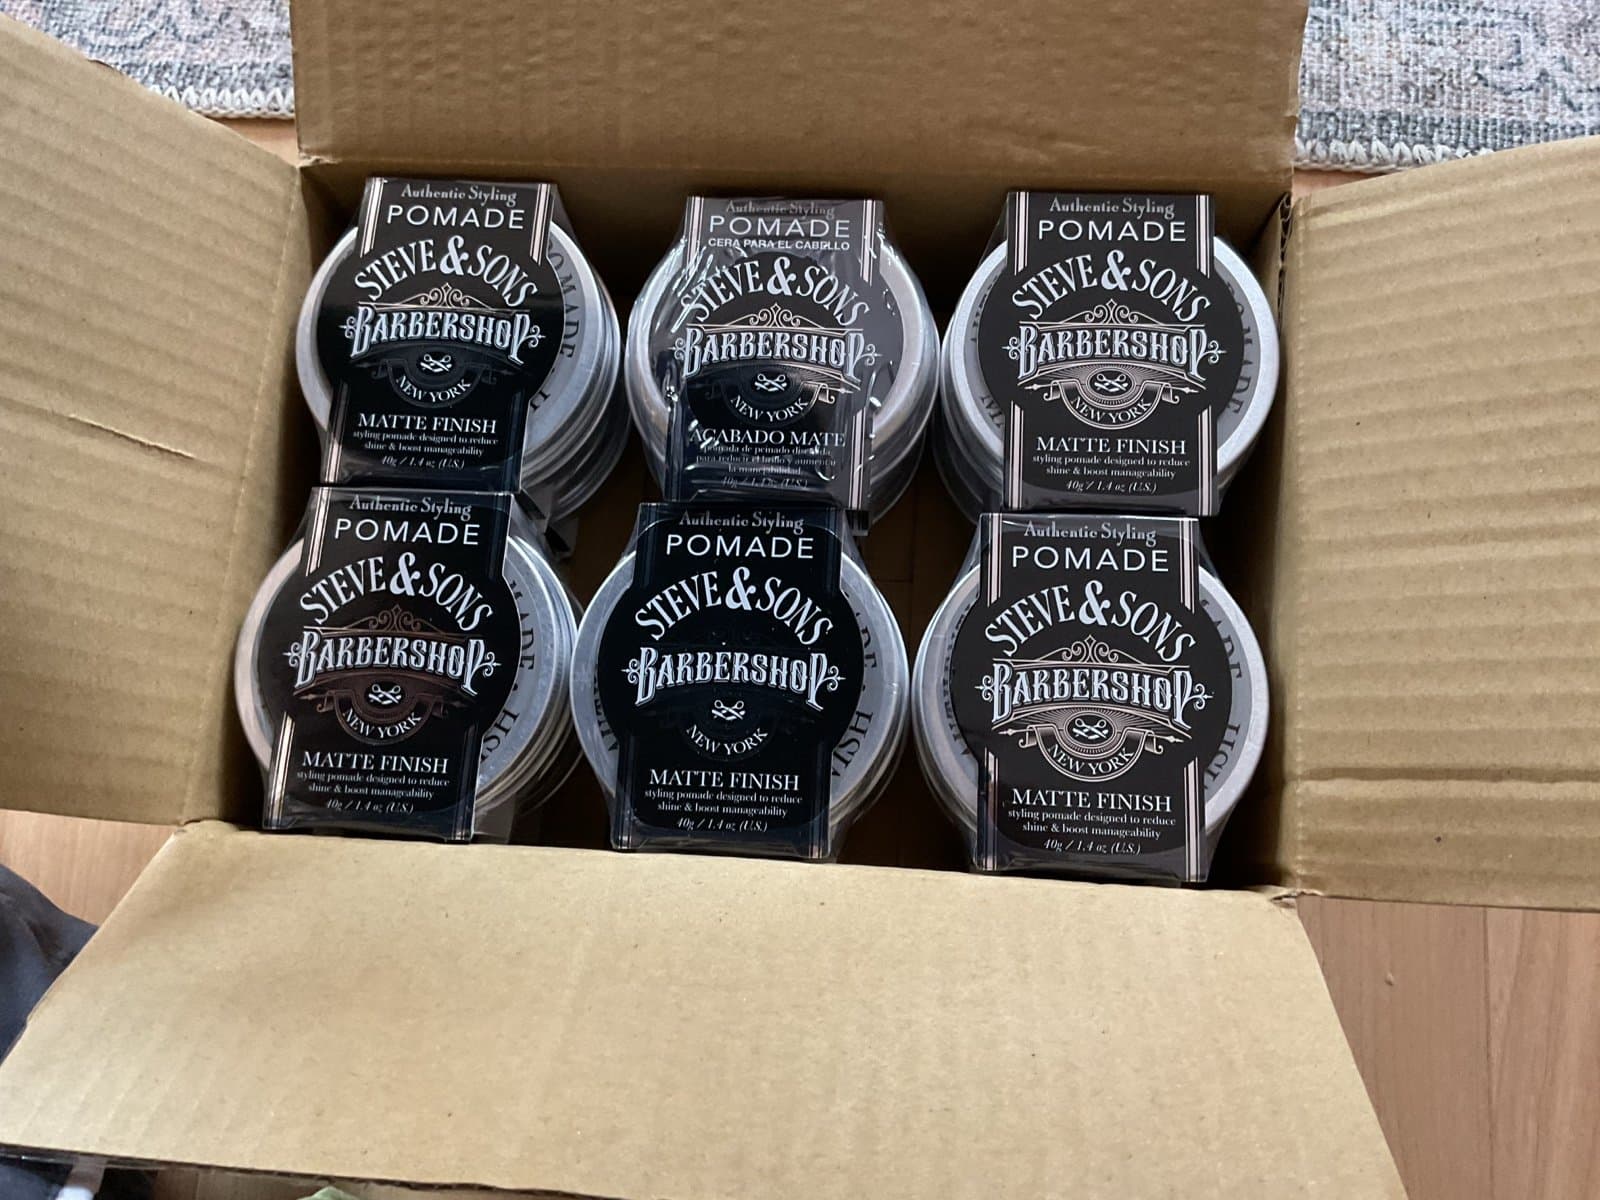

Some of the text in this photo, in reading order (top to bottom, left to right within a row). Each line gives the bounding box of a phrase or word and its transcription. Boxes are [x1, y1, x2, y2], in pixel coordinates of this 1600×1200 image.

[401, 187, 517, 207] Authentic Styling
[387, 205, 525, 229] POMADE
[726, 201, 835, 220] Authentic Styling
[1050, 198, 1175, 219] Authentic Styling
[710, 216, 850, 238] POMADE
[1038, 221, 1186, 242] POMADE
[708, 238, 740, 247] CERA
[744, 239, 774, 248] PARA
[778, 241, 791, 249] EL
[395, 376, 472, 403] NEW YORK
[731, 395, 808, 422] NEW YORK
[1071, 397, 1154, 423] NEW YORK
[358, 413, 496, 434] MATTE FINISH
[690, 429, 845, 447] ACABADO MATE
[1037, 437, 1186, 455] MATTE FINISH
[1033, 454, 1062, 464] styling
[1065, 456, 1100, 465] pomade
[1104, 457, 1144, 466] designed
[1084, 467, 1107, 475] boost
[349, 498, 472, 521] Authentic Styling
[335, 519, 480, 545] POMADE
[679, 513, 805, 535] Authentic Styling
[1024, 524, 1156, 546] Authentic Styling
[666, 535, 814, 559] POMADE
[1012, 546, 1169, 573] POMADE
[342, 710, 422, 738] NEW YORK
[686, 725, 769, 755] NEW YORK
[302, 752, 448, 773] MATTE FINISH
[1049, 744, 1134, 774] NEW YORK
[649, 769, 800, 790] MATTE FINISH
[645, 788, 802, 803] styling pomade designed to reduce
[1012, 789, 1172, 812] MATTE FINISH
[658, 801, 681, 810] shine
[695, 802, 719, 813] boost
[1008, 809, 1176, 826] styling pomade designed to reduce
[1022, 822, 1048, 831] shine
[1051, 823, 1060, 832] &
[1063, 823, 1088, 834] boost
